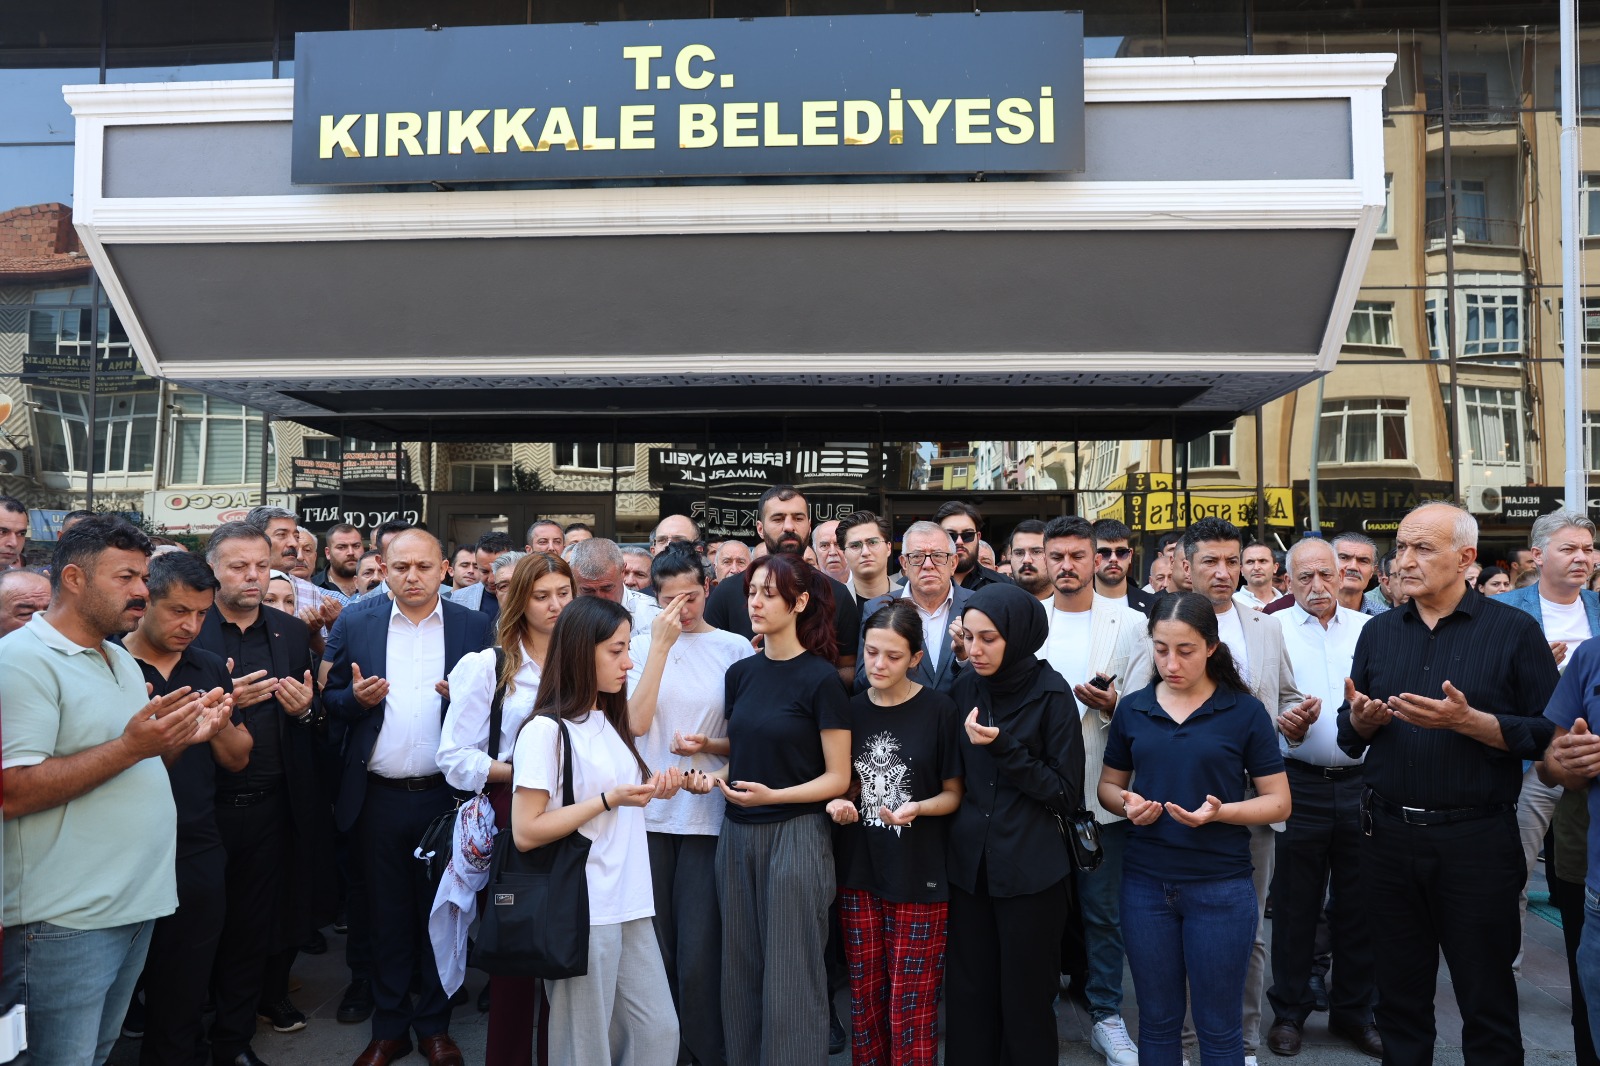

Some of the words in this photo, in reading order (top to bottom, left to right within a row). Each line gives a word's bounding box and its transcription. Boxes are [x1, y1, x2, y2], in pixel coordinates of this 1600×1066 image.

[623, 44, 734, 91] T.C.
[319, 104, 656, 159] KIRIKKALE
[679, 86, 1055, 150] BELEDİYESİ
